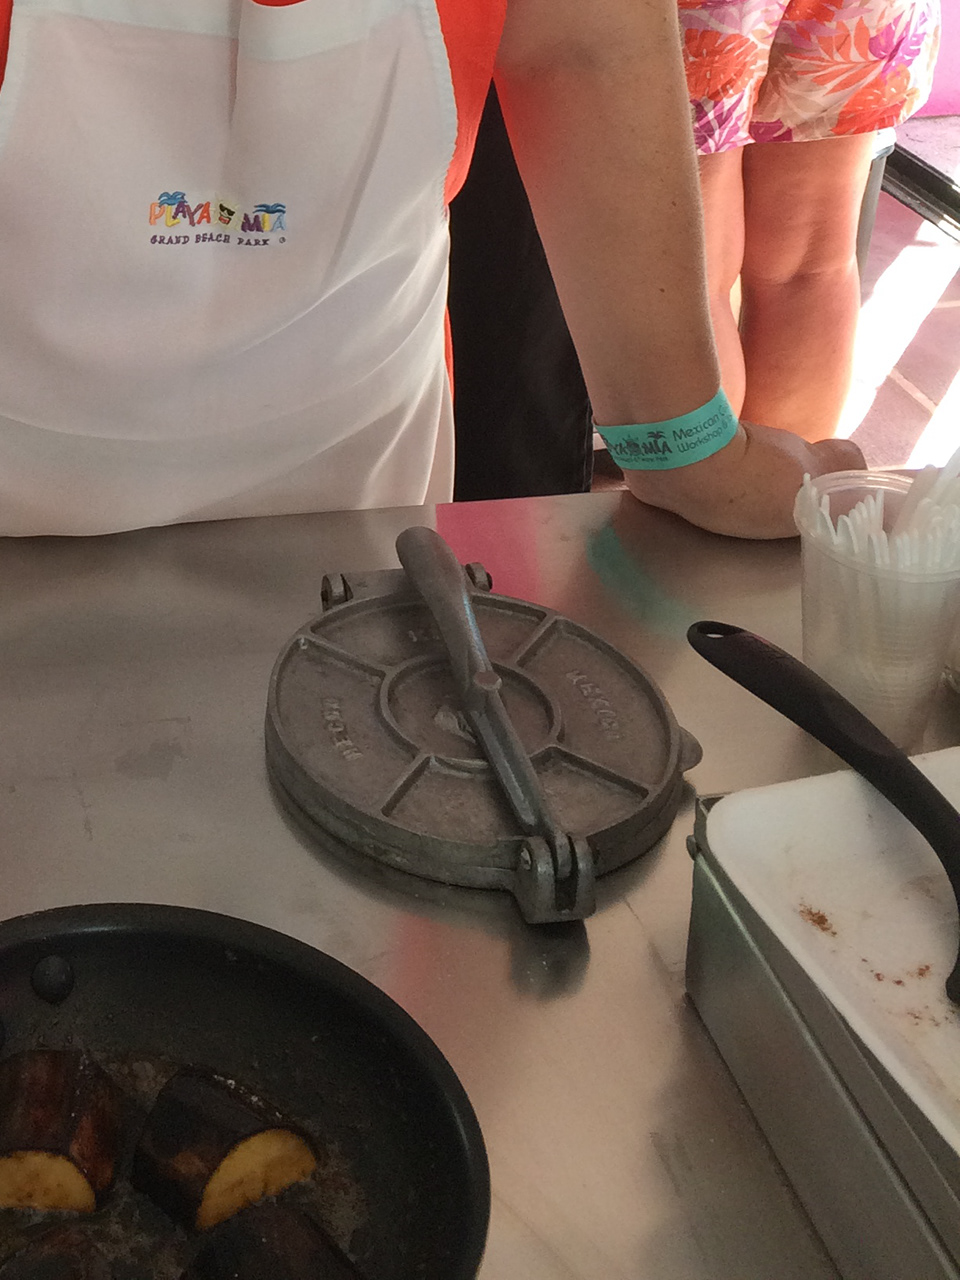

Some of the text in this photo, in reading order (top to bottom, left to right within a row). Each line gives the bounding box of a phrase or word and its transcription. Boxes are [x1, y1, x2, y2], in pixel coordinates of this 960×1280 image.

[149, 201, 286, 232] PLAYA MIA
[150, 232, 270, 246] GRAND BEACH PARK
[672, 413, 720, 441] Mexican
[677, 426, 723, 453] Workshop
